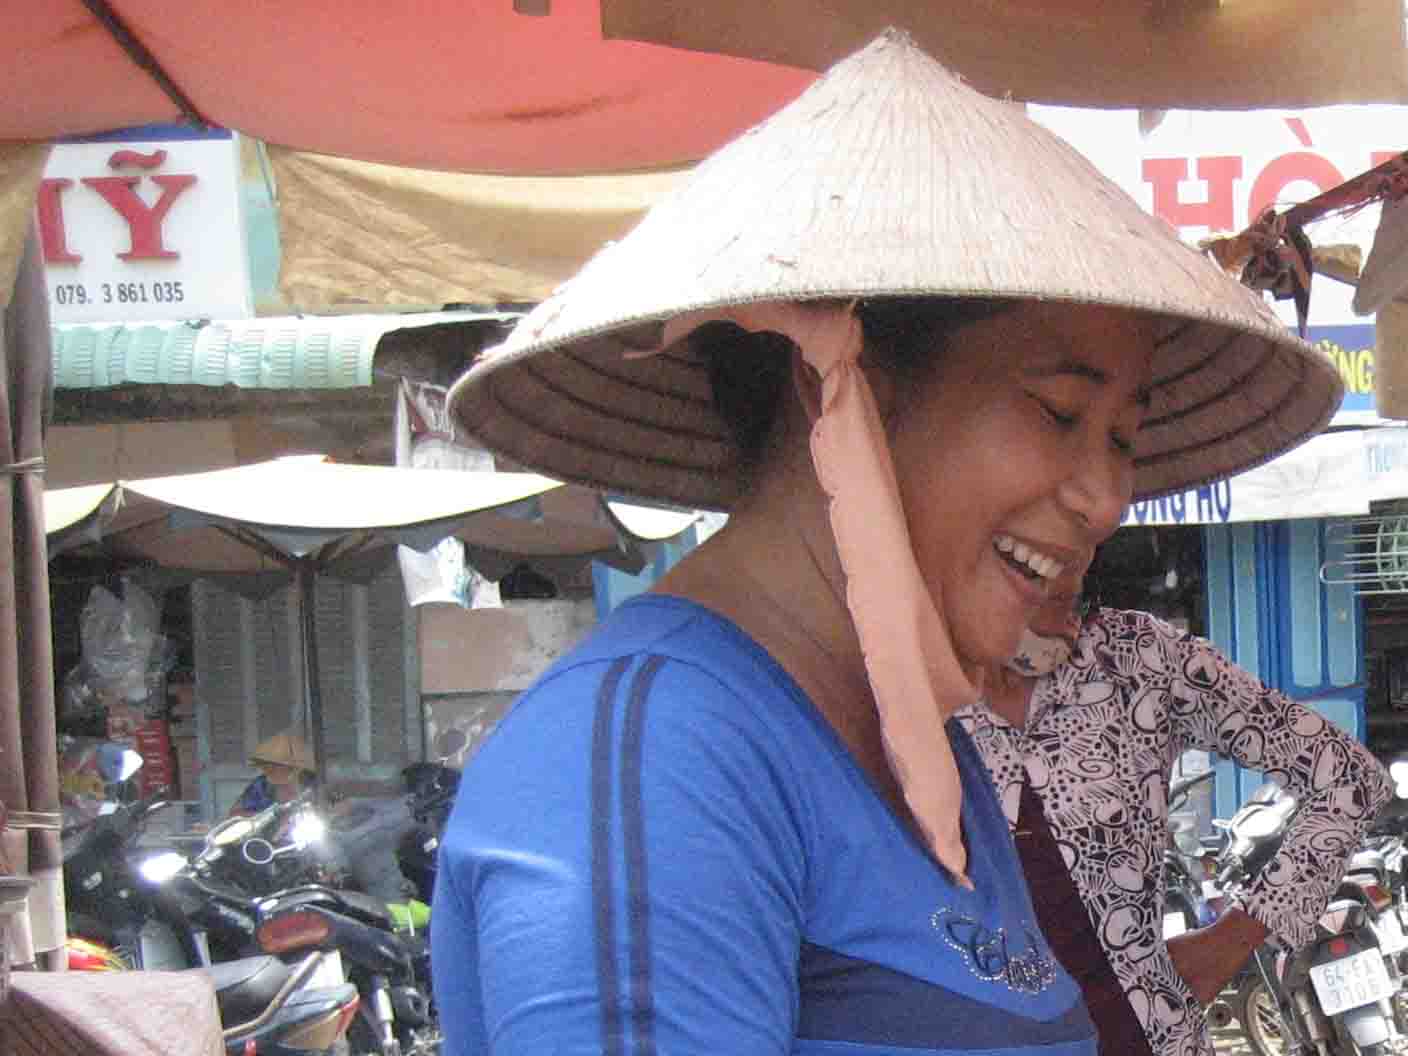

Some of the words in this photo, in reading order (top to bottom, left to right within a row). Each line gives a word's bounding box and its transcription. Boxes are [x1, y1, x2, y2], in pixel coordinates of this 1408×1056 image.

[56, 284, 93, 304] 079.
[102, 283, 112, 303] 3
[117, 282, 147, 302] 861
[153, 281, 184, 302] 035
